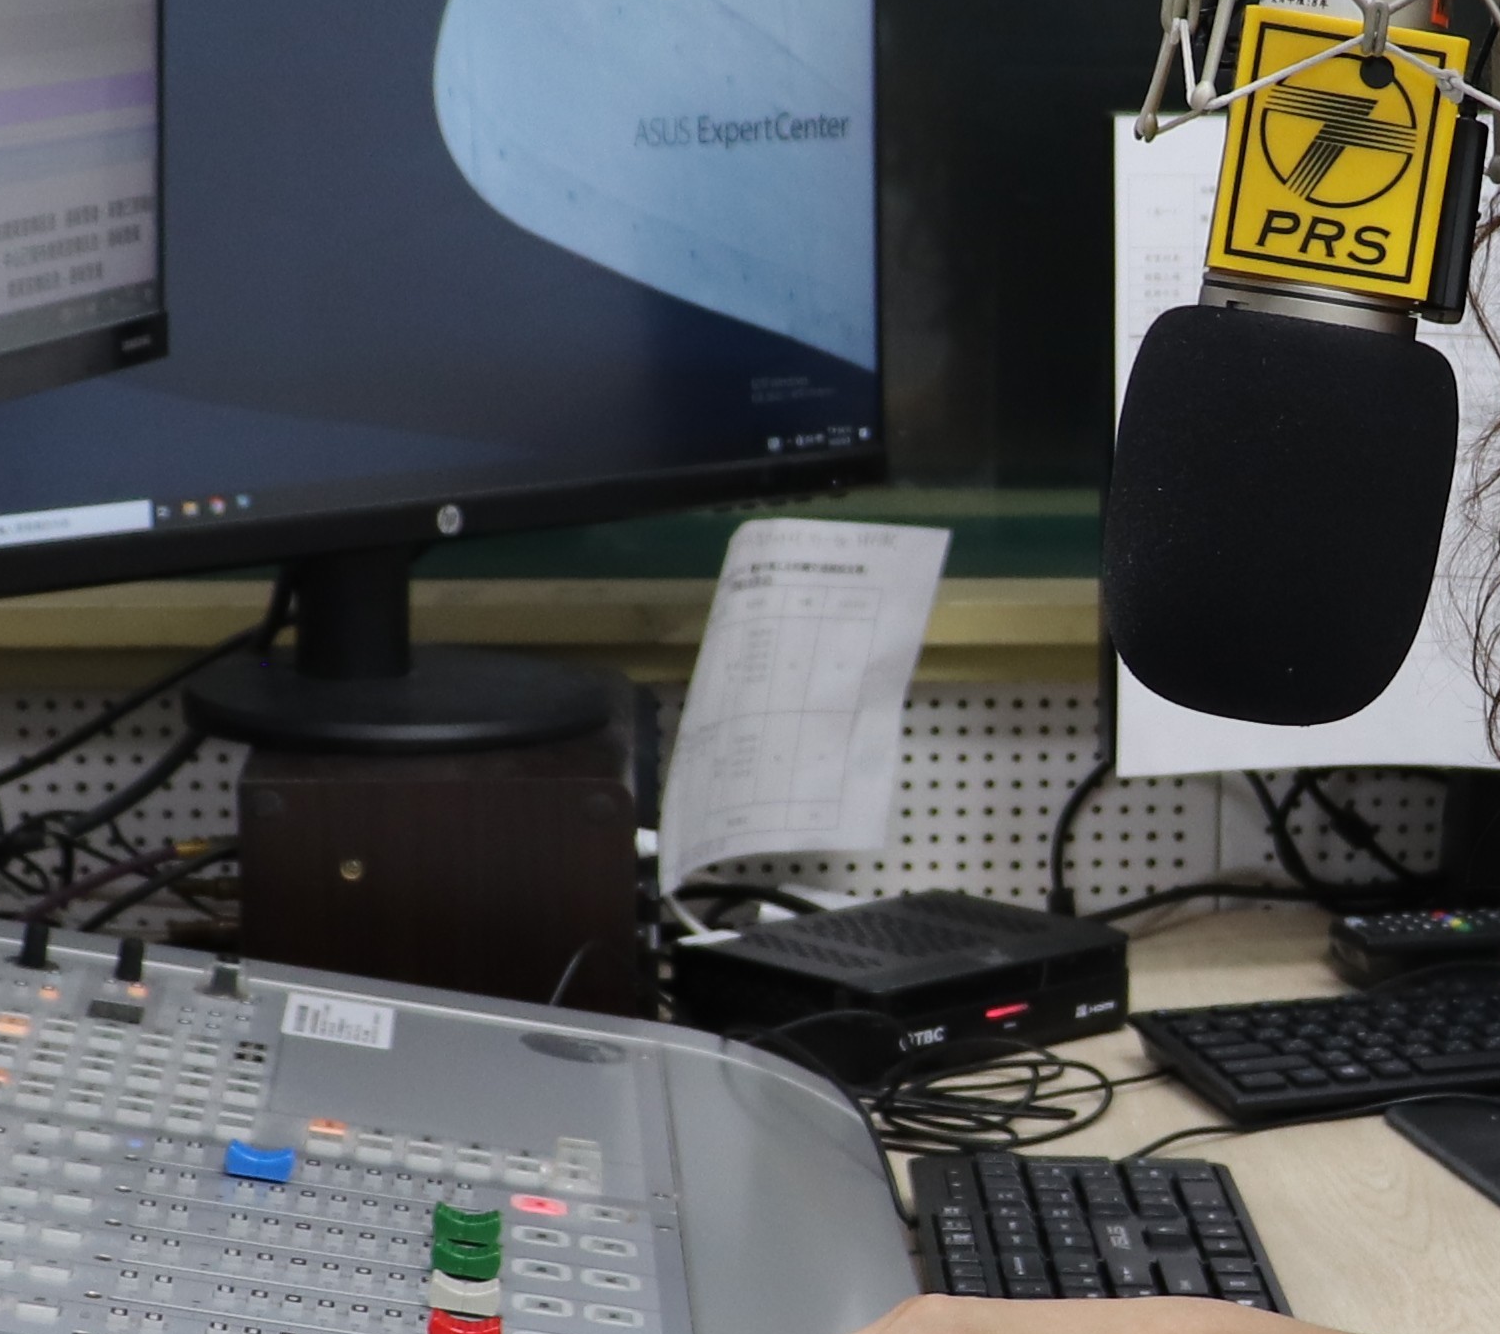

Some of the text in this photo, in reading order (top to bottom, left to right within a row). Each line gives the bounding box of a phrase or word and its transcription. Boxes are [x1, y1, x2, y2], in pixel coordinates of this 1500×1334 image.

[634, 117, 691, 146] ASUS
[1255, 208, 1393, 267] PRS
[915, 1026, 945, 1047] TBC
